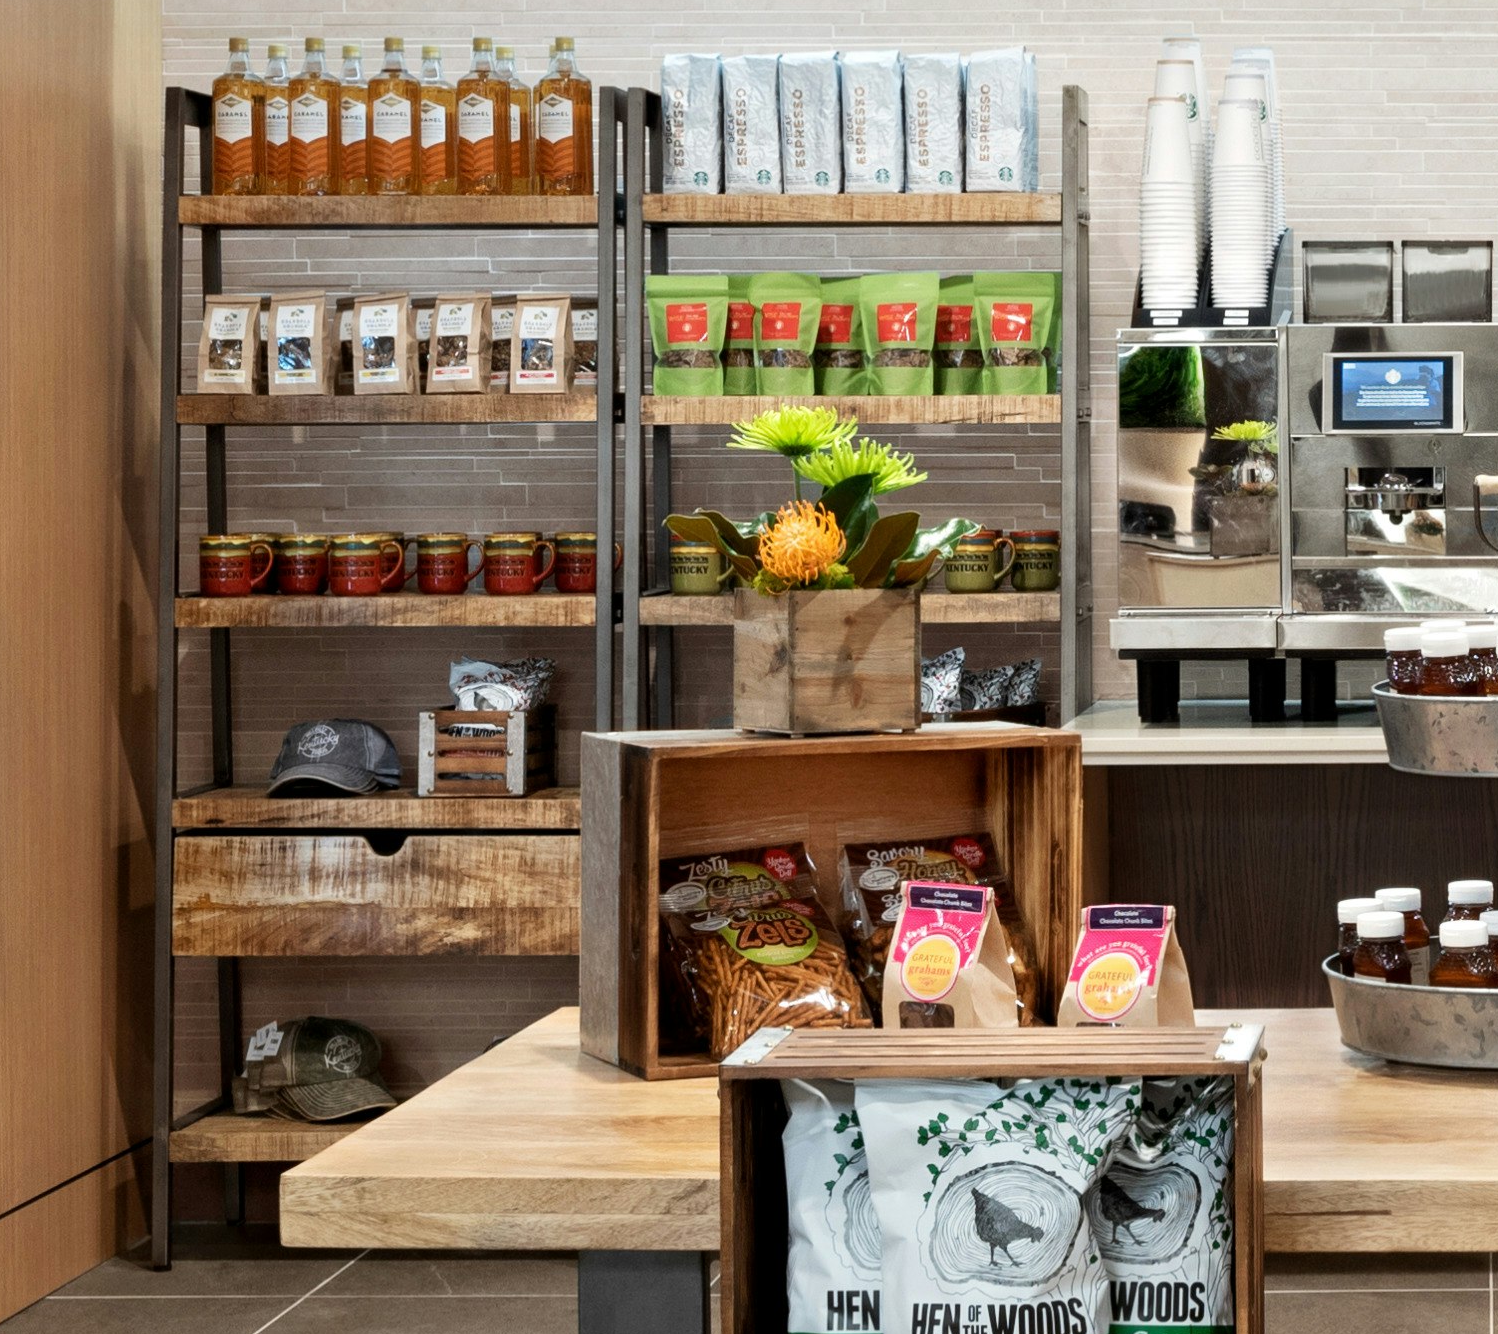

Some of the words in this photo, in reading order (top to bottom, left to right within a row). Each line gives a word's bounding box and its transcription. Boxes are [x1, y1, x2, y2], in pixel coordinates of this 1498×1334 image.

[665, 113, 673, 144] DECAF
[673, 89, 684, 167] ESPRESSO
[727, 113, 735, 144] DECAF
[735, 88, 748, 166] ESPRESSO
[784, 115, 792, 145] DECAF
[792, 88, 804, 168] ESPRESSO
[846, 111, 854, 142] DECAF
[855, 86, 866, 165] ESPRESSO
[908, 114, 916, 145] DECAF
[917, 89, 928, 167] ESPRESSO
[969, 110, 977, 140] DECAF
[978, 84, 990, 162] ESPRESSO
[297, 733, 339, 755] Kentucky
[679, 855, 729, 882] Zesty
[867, 846, 925, 868] Savory
[907, 964, 951, 976] grahams
[912, 953, 954, 964] GRATEFUL
[1089, 971, 1134, 982] GRATEFUL
[827, 1290, 880, 1331] HEN
[968, 1304, 982, 1323] OF
[1110, 1281, 1206, 1323] WOODS
